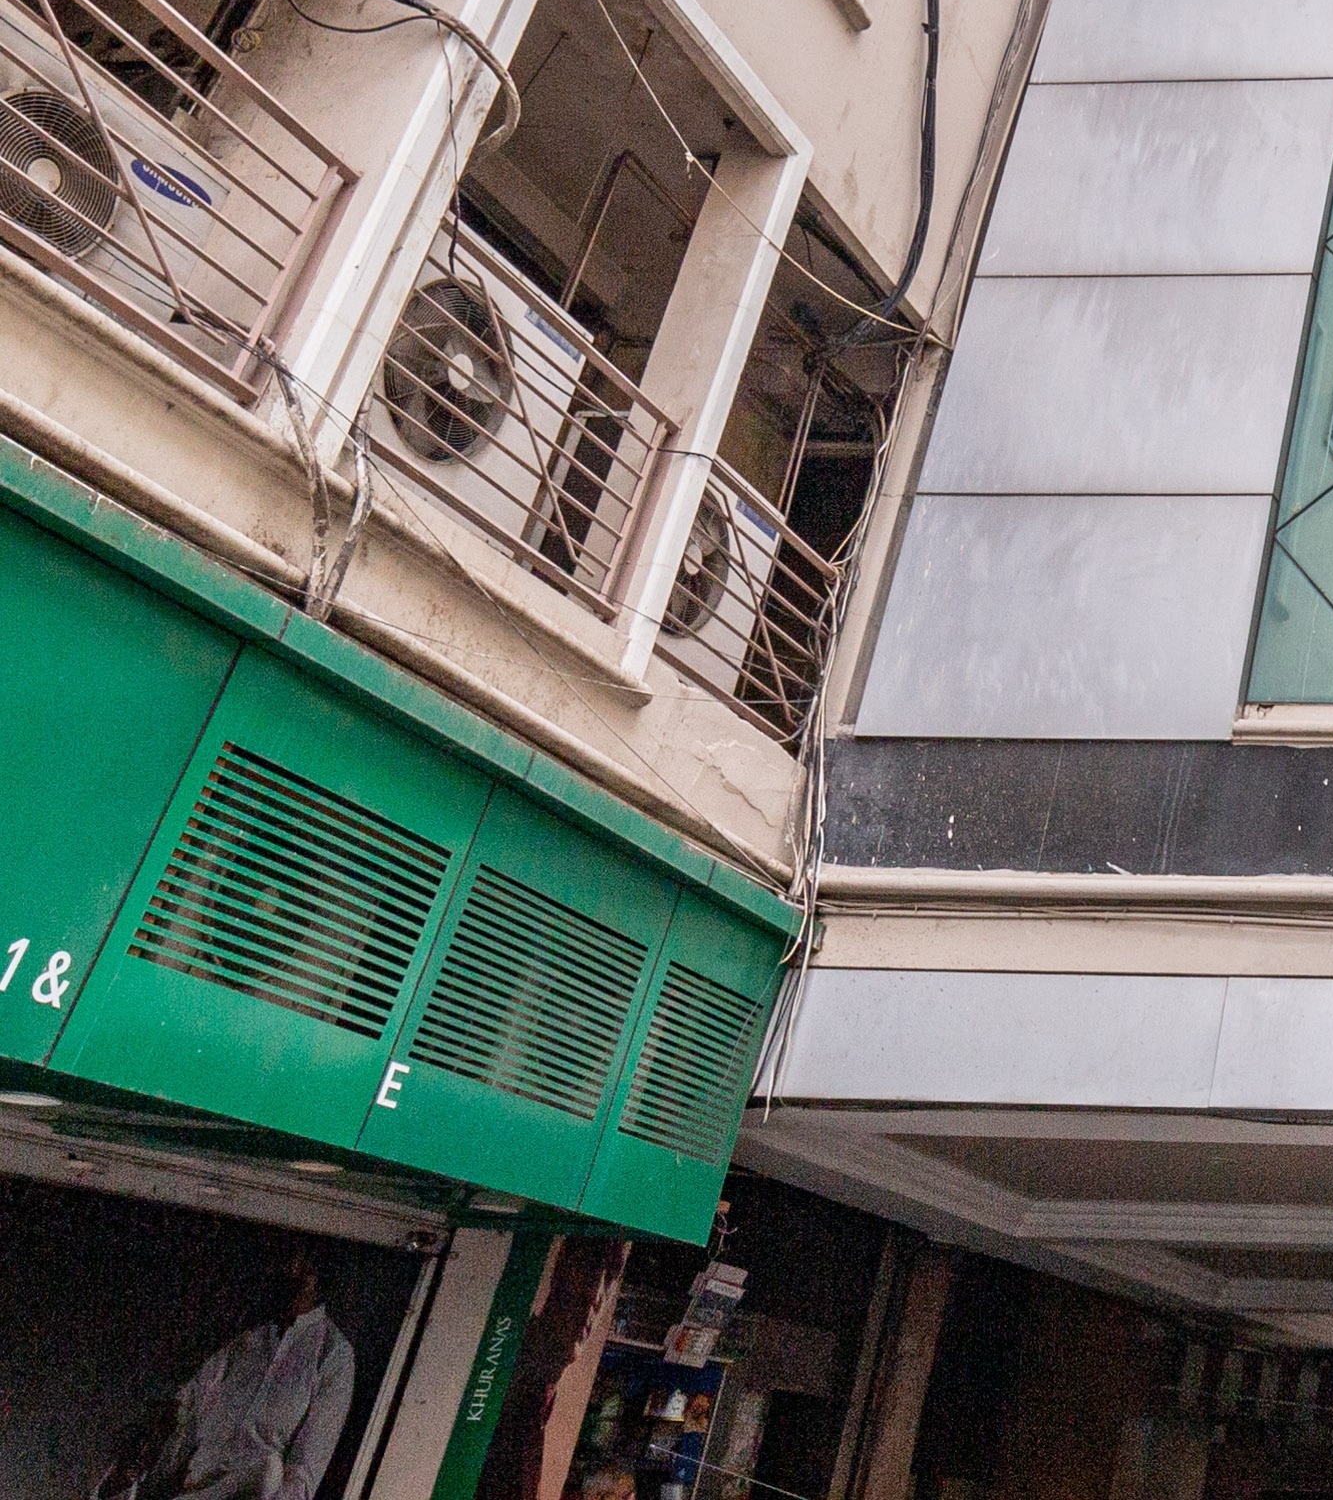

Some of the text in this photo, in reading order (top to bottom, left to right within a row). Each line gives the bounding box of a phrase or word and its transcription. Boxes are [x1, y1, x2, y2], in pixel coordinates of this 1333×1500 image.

[0, 937, 71, 1009] 1 &
[377, 1061, 411, 1110] E
